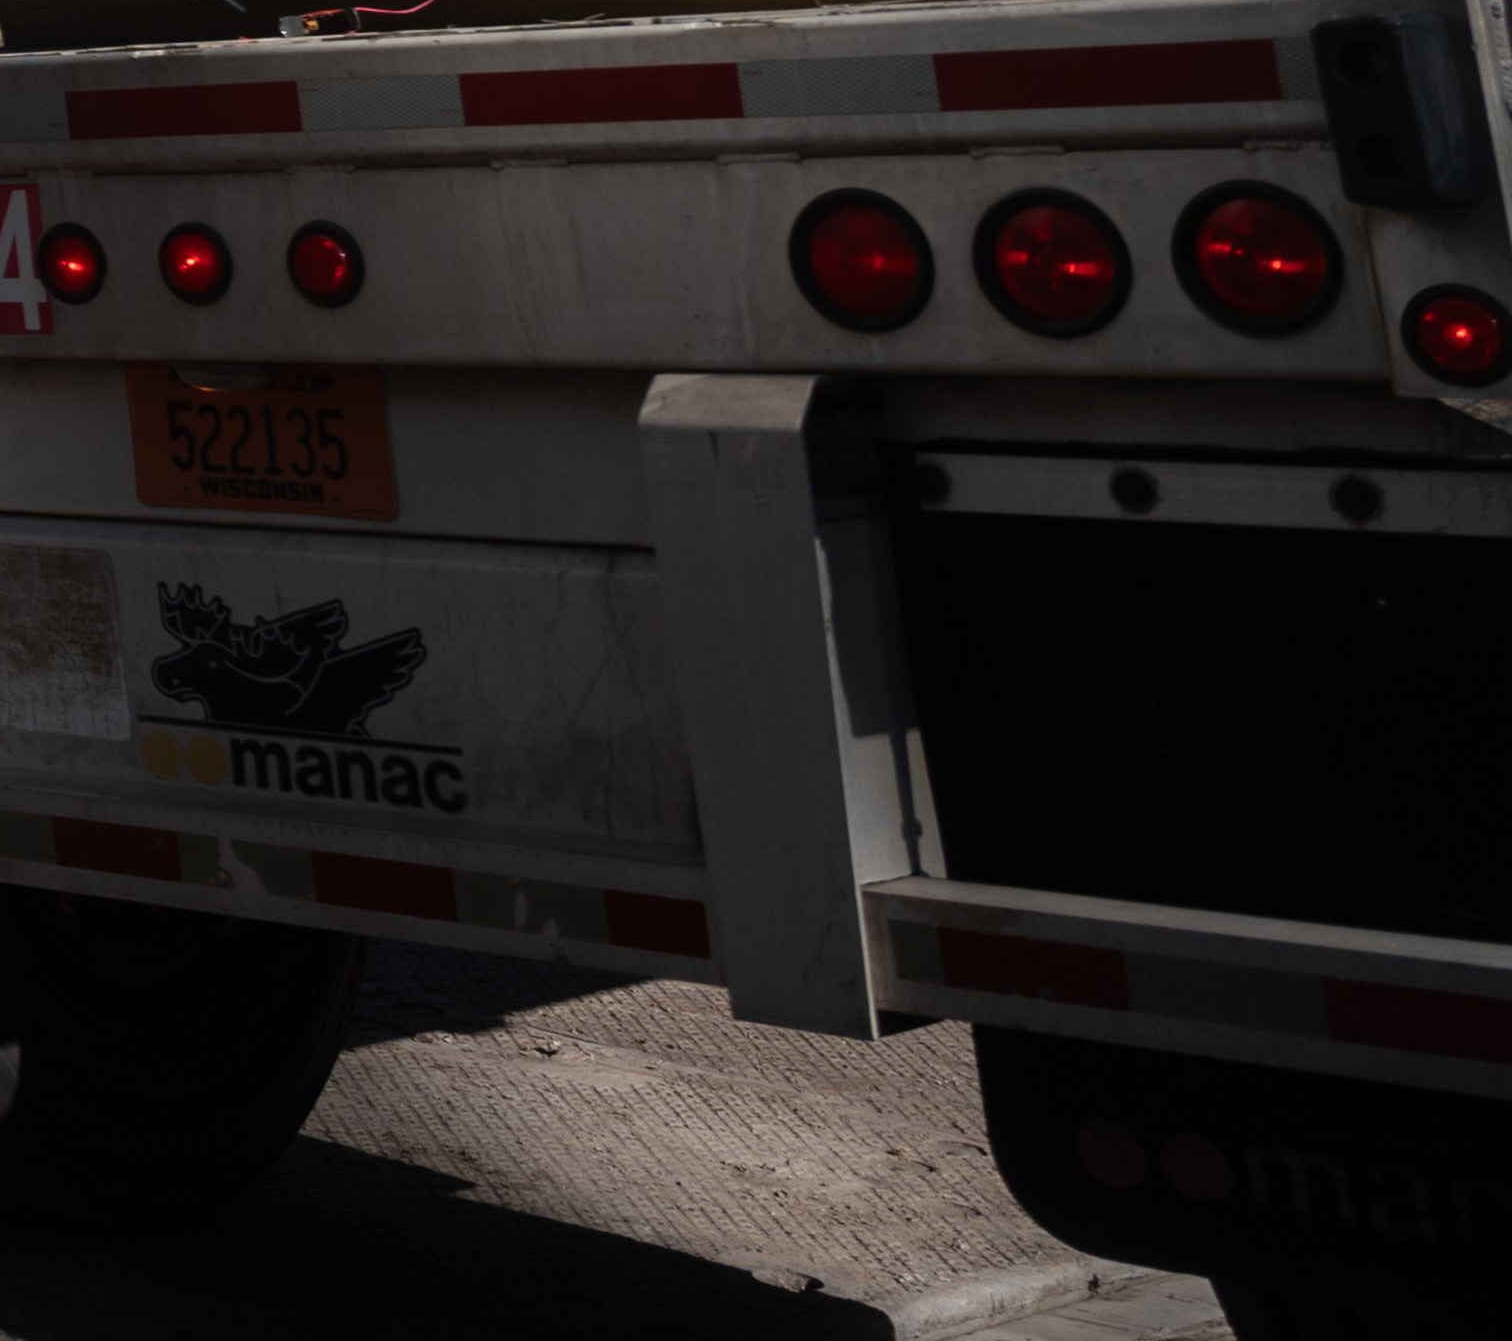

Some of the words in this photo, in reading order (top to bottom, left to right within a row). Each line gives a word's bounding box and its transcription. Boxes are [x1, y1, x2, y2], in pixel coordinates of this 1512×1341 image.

[167, 400, 348, 480] 522135
[198, 476, 324, 502] WISCONSIN
[229, 737, 468, 813] manac
